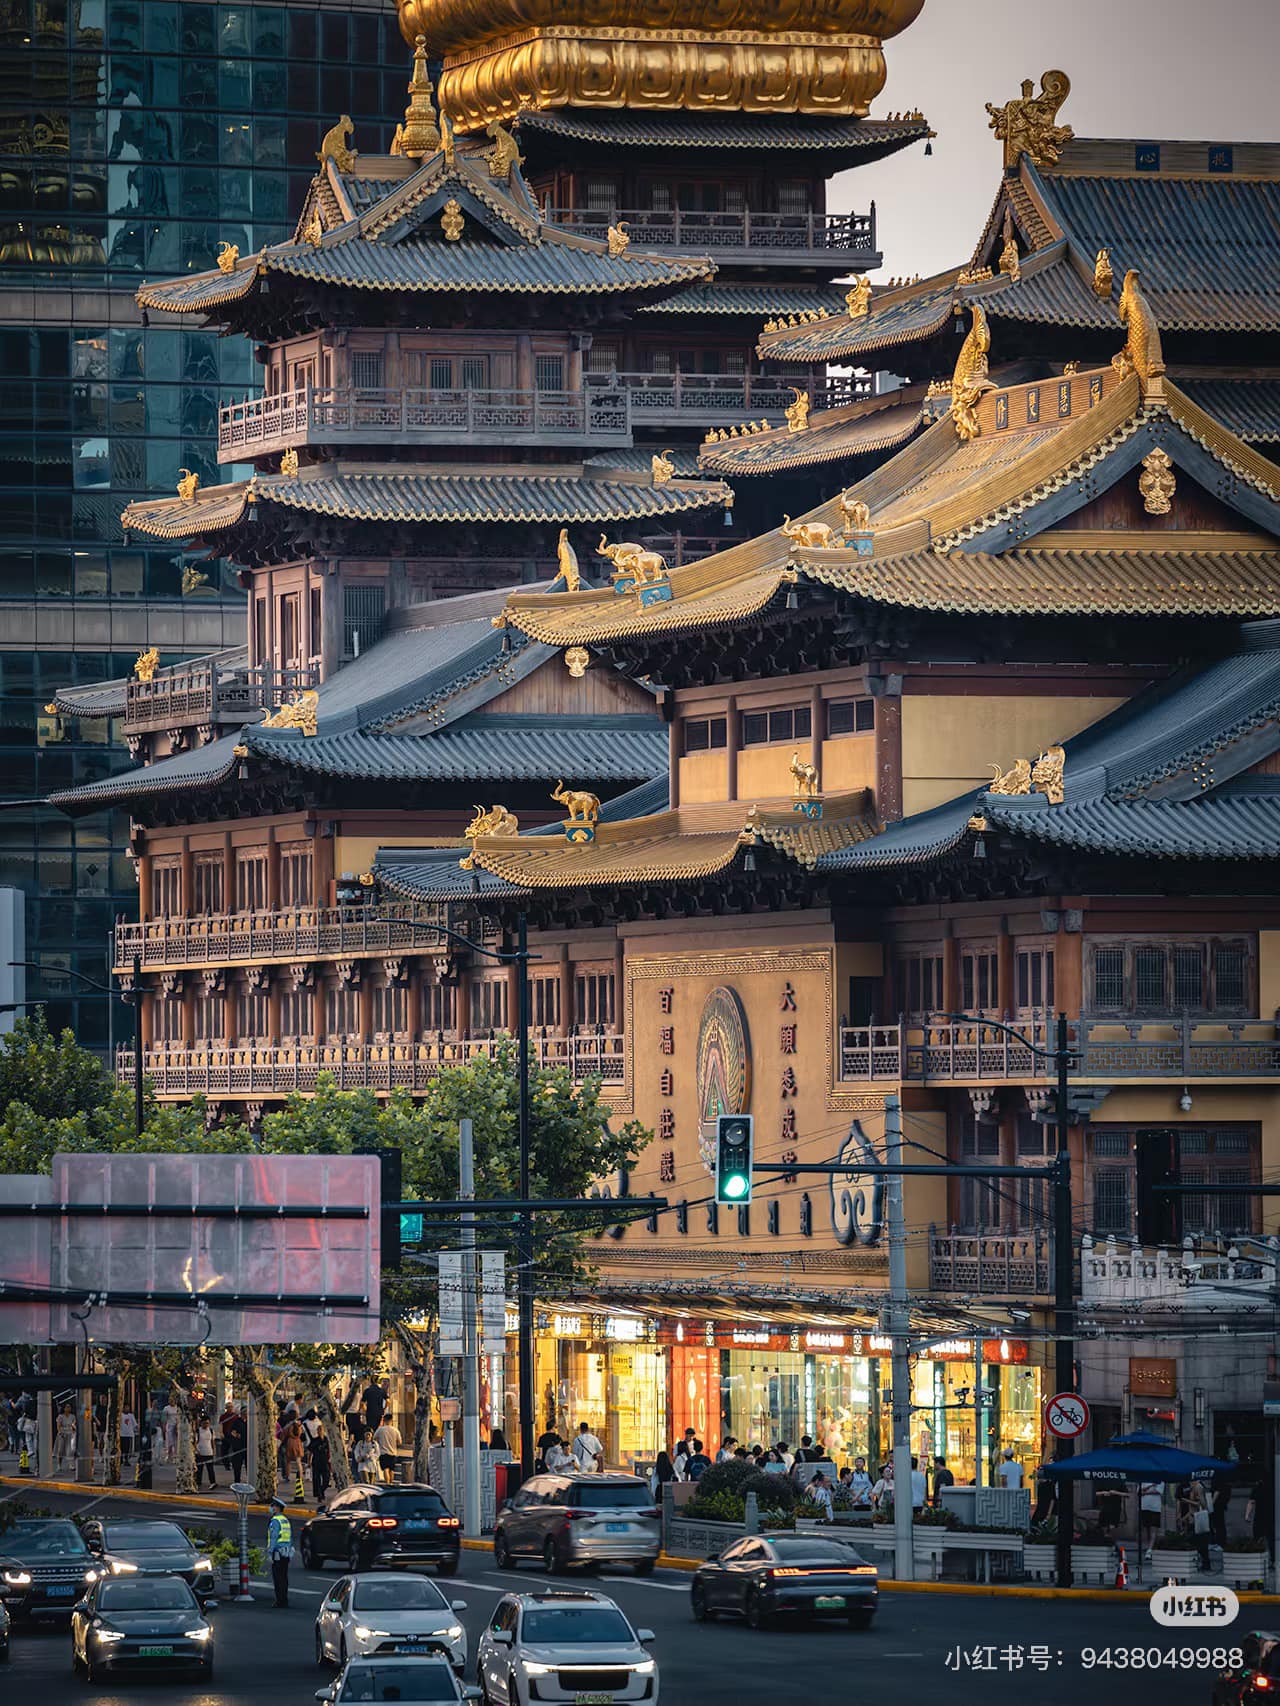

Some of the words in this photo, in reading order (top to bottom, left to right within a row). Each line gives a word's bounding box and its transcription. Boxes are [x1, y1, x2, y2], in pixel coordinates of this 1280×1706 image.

[658, 986, 675, 1183] 百福自莊嚴
[1092, 1471, 1119, 1479] POLICE
